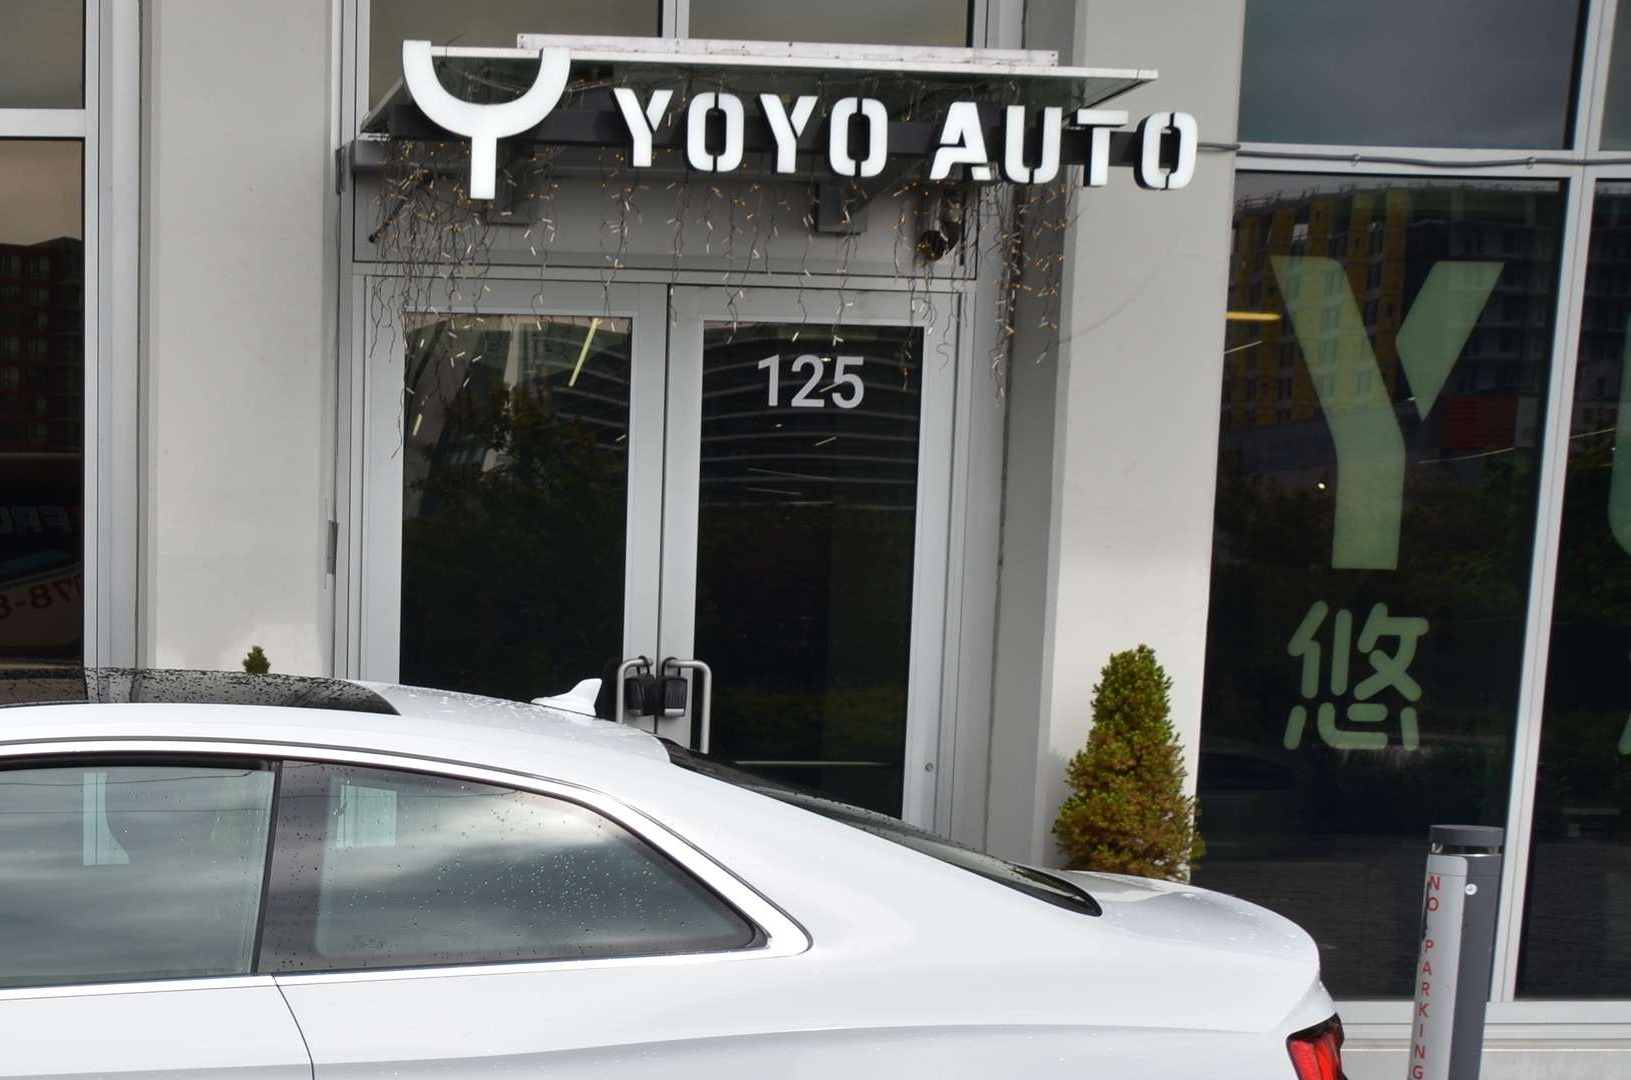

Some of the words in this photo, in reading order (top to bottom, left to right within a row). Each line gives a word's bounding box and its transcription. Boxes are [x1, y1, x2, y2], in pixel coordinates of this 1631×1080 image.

[611, 87, 889, 178] YOYO
[928, 100, 1199, 191] AUTO
[758, 354, 866, 410] 125
[1283, 600, 1430, 752] 悠
[1426, 874, 1441, 912] NO
[1411, 938, 1435, 1080] PARKING
